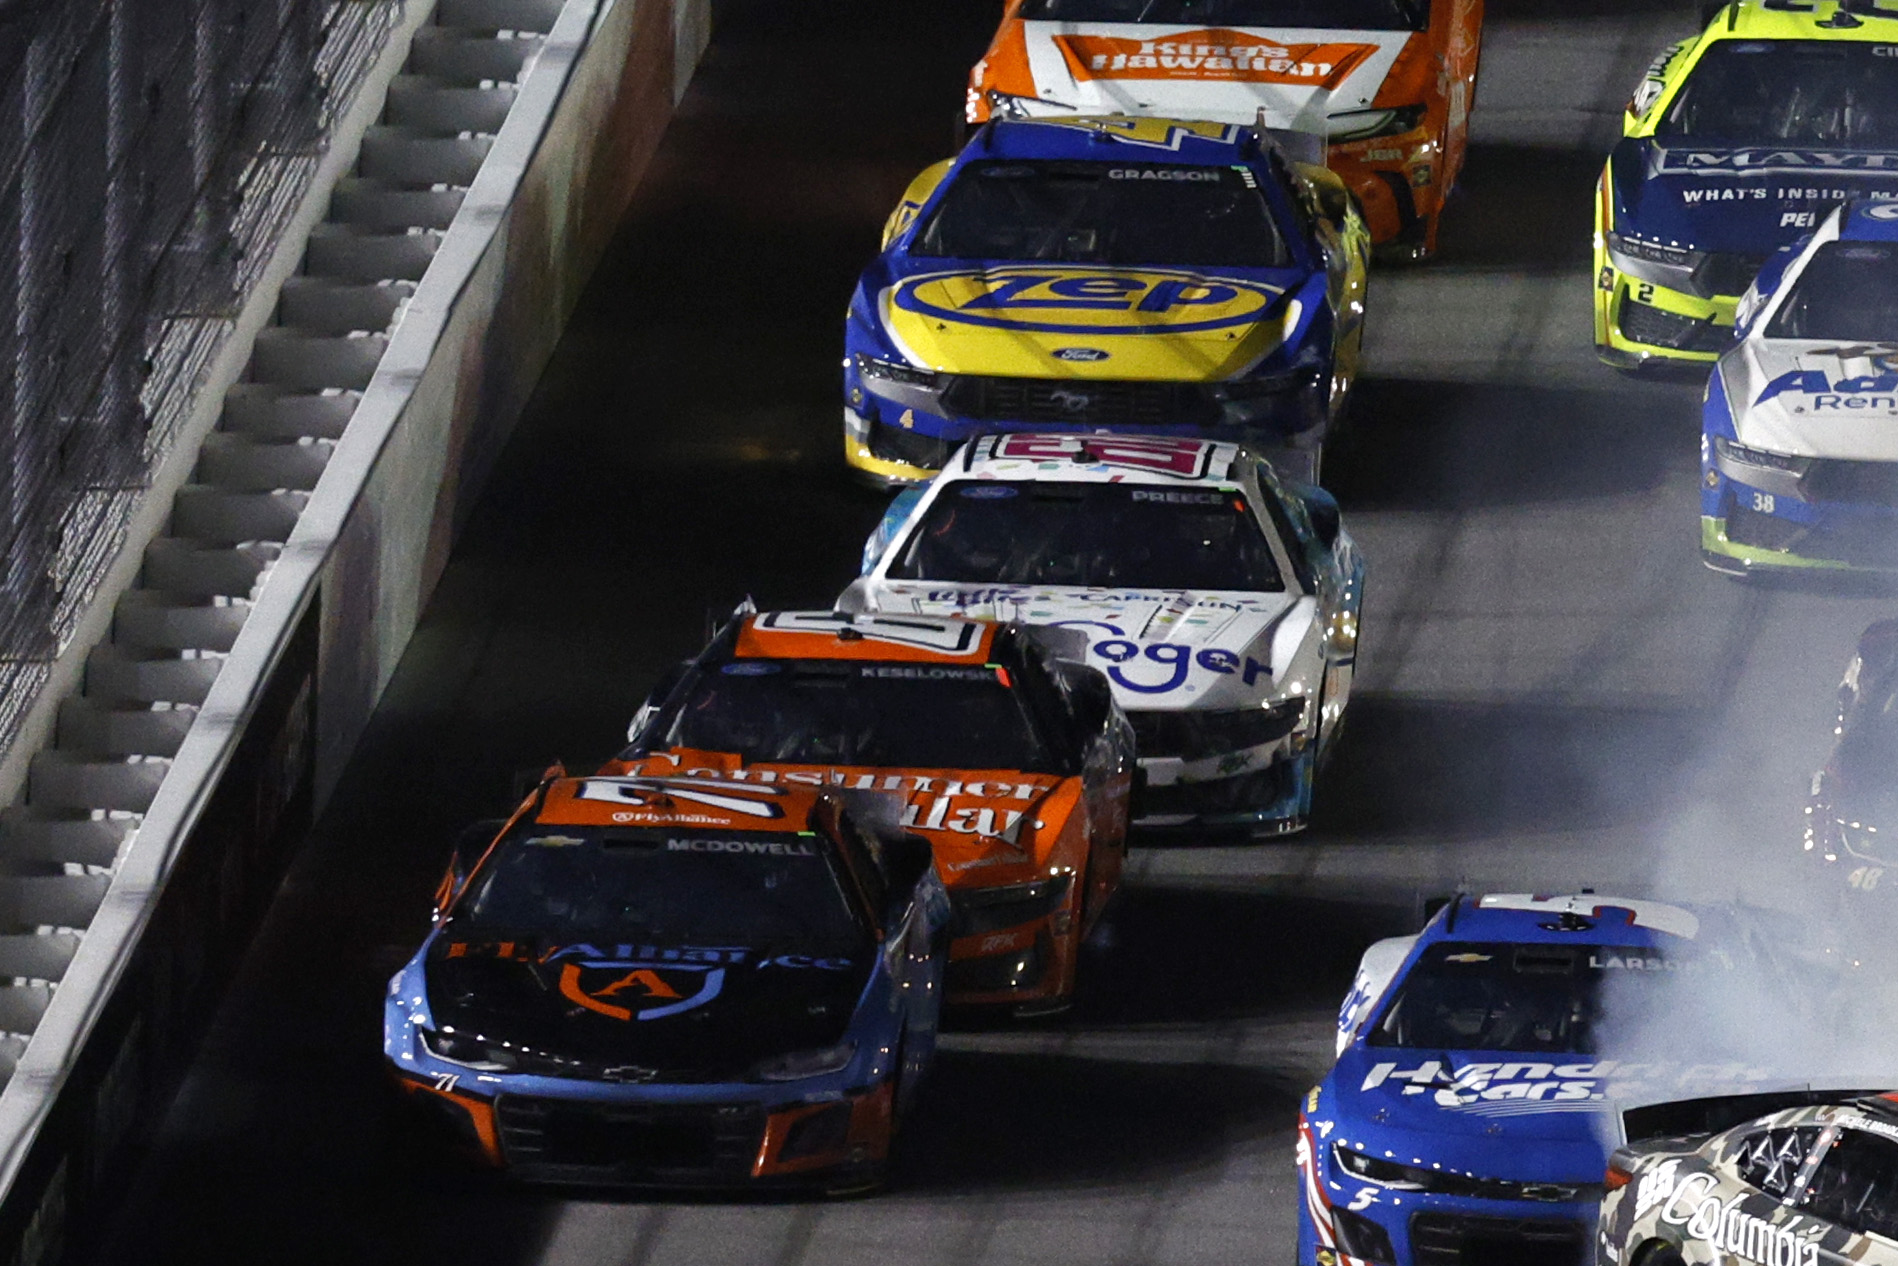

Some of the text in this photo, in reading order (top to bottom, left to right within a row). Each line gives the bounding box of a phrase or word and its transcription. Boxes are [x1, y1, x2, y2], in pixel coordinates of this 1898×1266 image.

[1107, 169, 1220, 182] GRAGSON
[1683, 188, 1767, 204] WHAT'S
[1777, 187, 1860, 201] INSID
[1638, 283, 1655, 303] 2
[899, 409, 914, 429] 4
[1752, 493, 1775, 514] 38
[861, 666, 998, 682] KESELOWSK
[1092, 638, 1274, 695] oger
[667, 837, 816, 857] MCDOWELL
[434, 1072, 461, 1092] 71
[1347, 1187, 1380, 1211] 5
